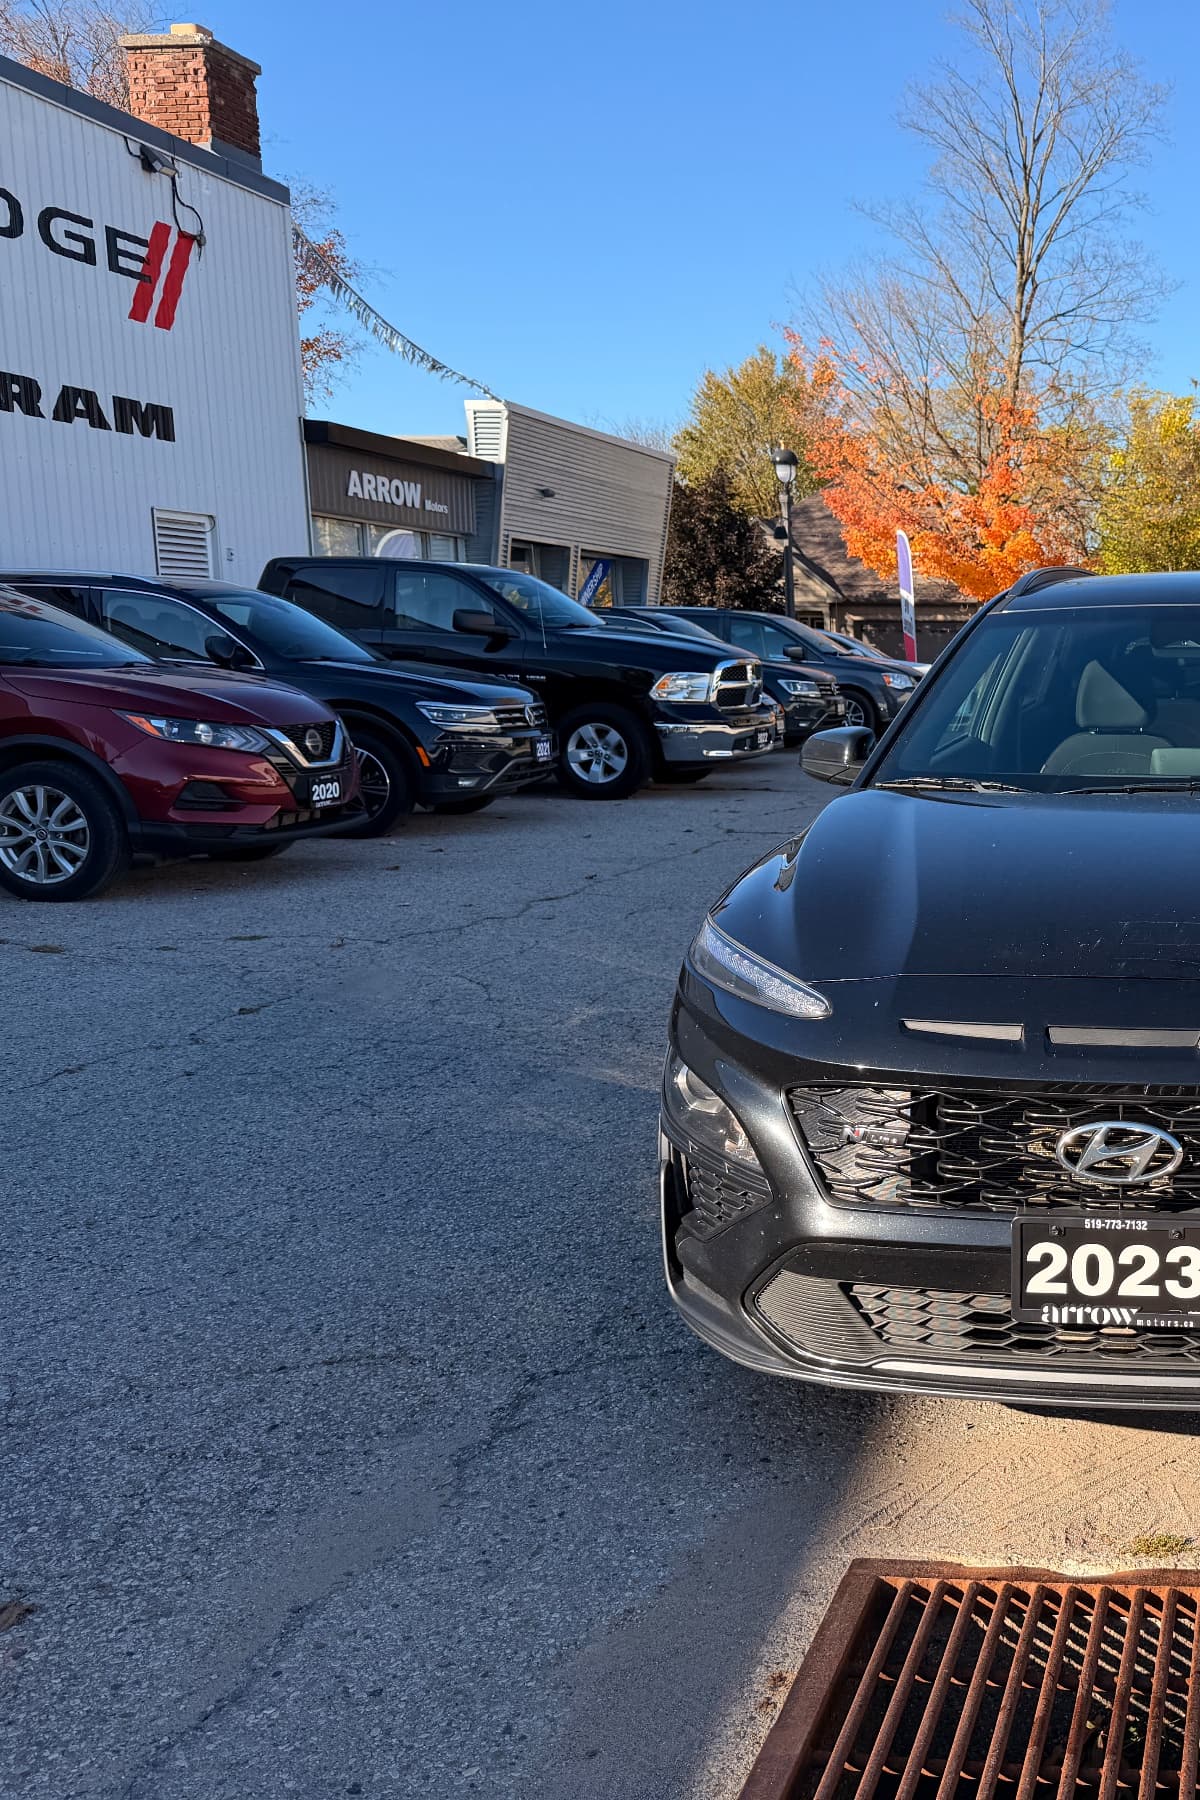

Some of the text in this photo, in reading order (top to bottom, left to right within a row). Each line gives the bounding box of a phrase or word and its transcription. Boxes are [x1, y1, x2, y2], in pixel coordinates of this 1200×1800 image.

[0, 371, 176, 442] RAM
[347, 470, 449, 514] ARROW Motors
[536, 741, 550, 756] 2021
[311, 782, 340, 800] 2020
[1084, 1219, 1148, 1231] 519-773-7132
[1041, 1304, 1194, 1328] arrow motors.ca
